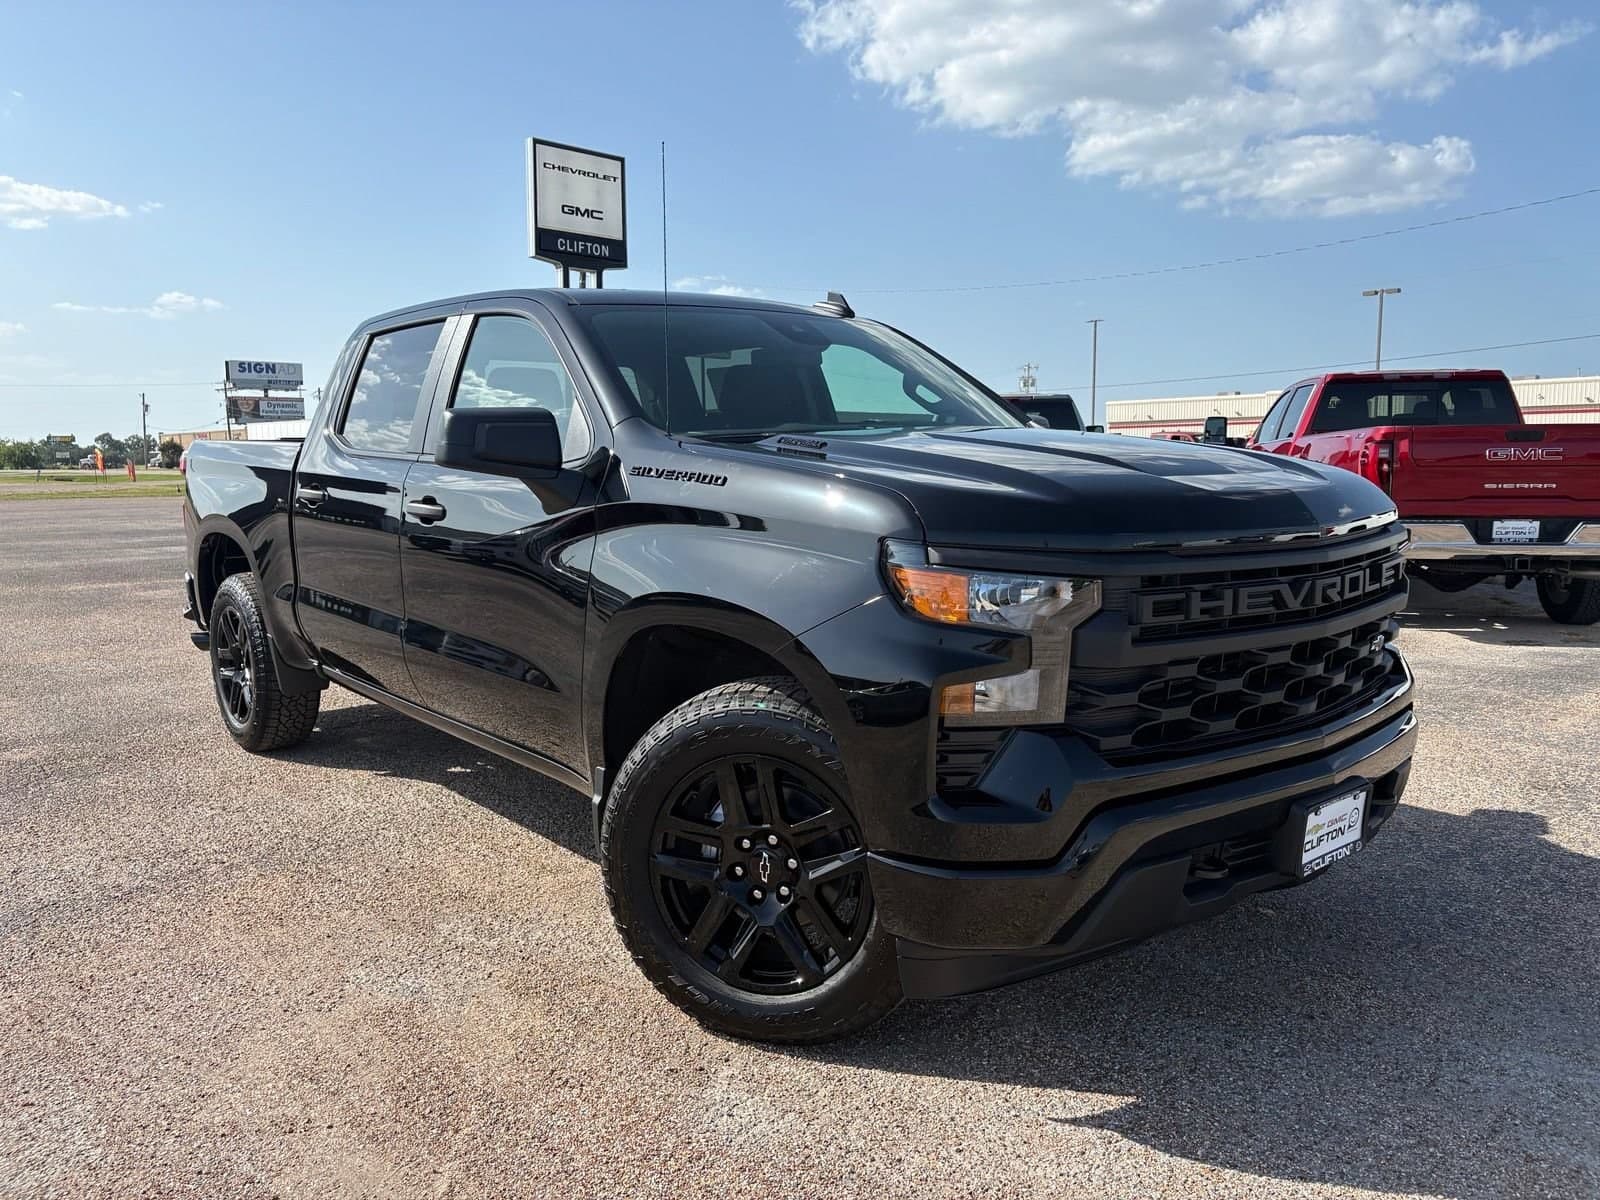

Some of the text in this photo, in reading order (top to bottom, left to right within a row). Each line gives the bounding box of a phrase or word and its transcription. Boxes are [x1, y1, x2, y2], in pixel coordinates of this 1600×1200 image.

[543, 162, 619, 182] CHEVROLET
[561, 204, 604, 220] GMC
[557, 238, 609, 256] CLIFTON
[1486, 447, 1563, 461] GMC
[629, 466, 728, 487] SILVERADO
[1327, 813, 1348, 829] GMC
[1303, 825, 1346, 853] CLIFTON
[1312, 844, 1351, 871] CLIFTON
